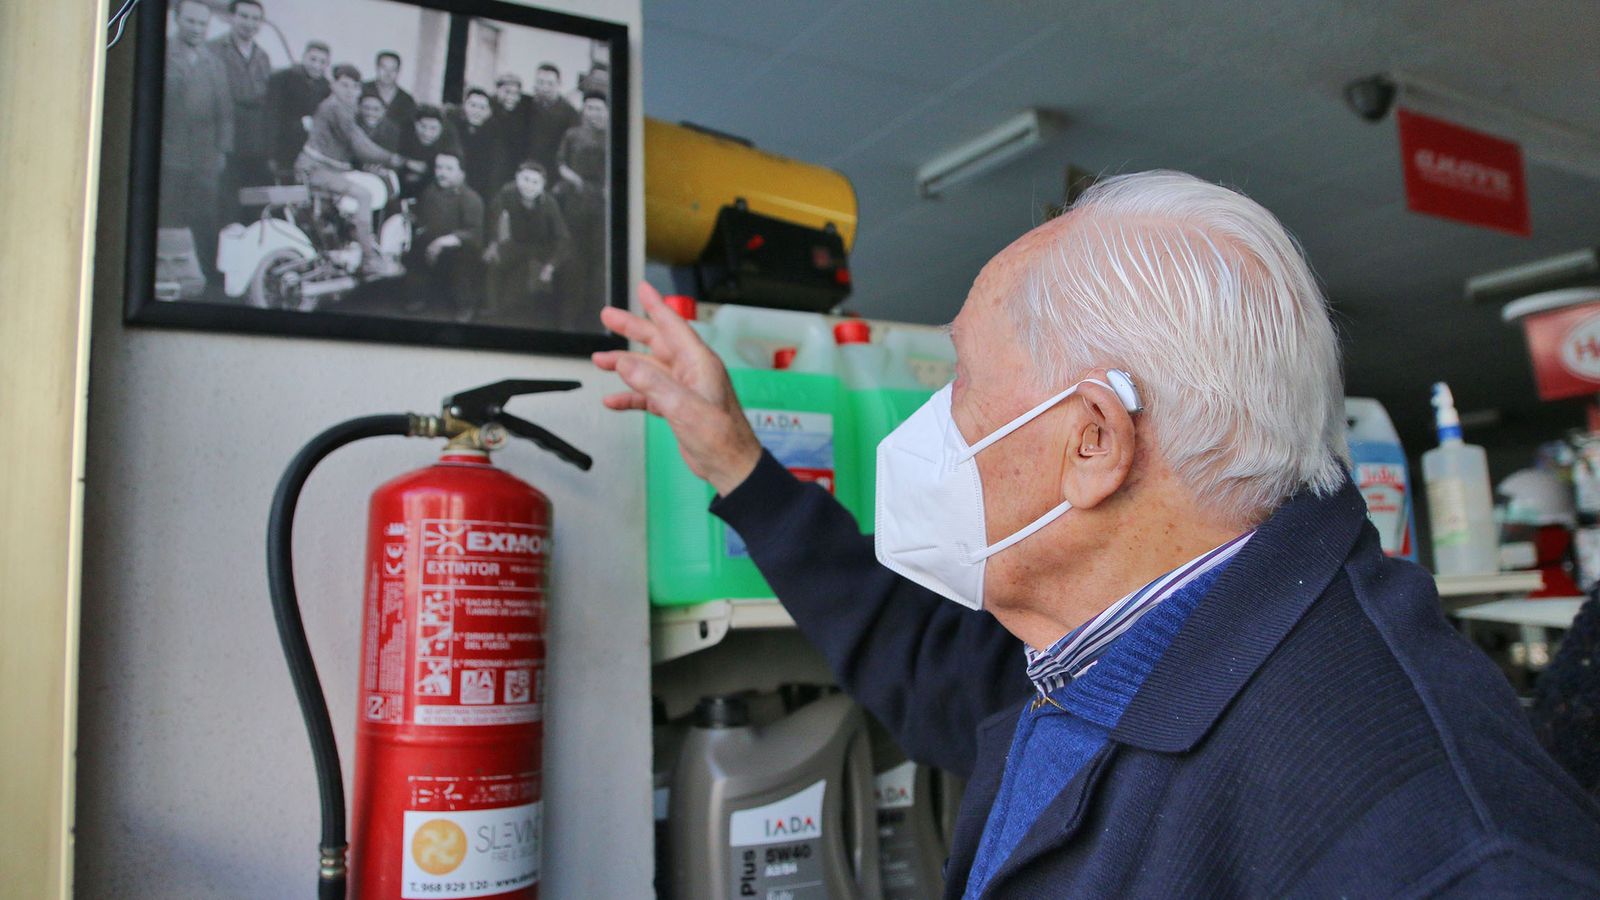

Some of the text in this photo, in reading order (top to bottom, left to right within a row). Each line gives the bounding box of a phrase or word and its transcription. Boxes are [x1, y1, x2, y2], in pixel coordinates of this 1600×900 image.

[755, 413, 804, 430] IADA
[426, 560, 501, 576] EXTINTOR
[765, 816, 817, 837] IADA
[764, 844, 812, 863] 5W40
[739, 849, 757, 897] Plus
